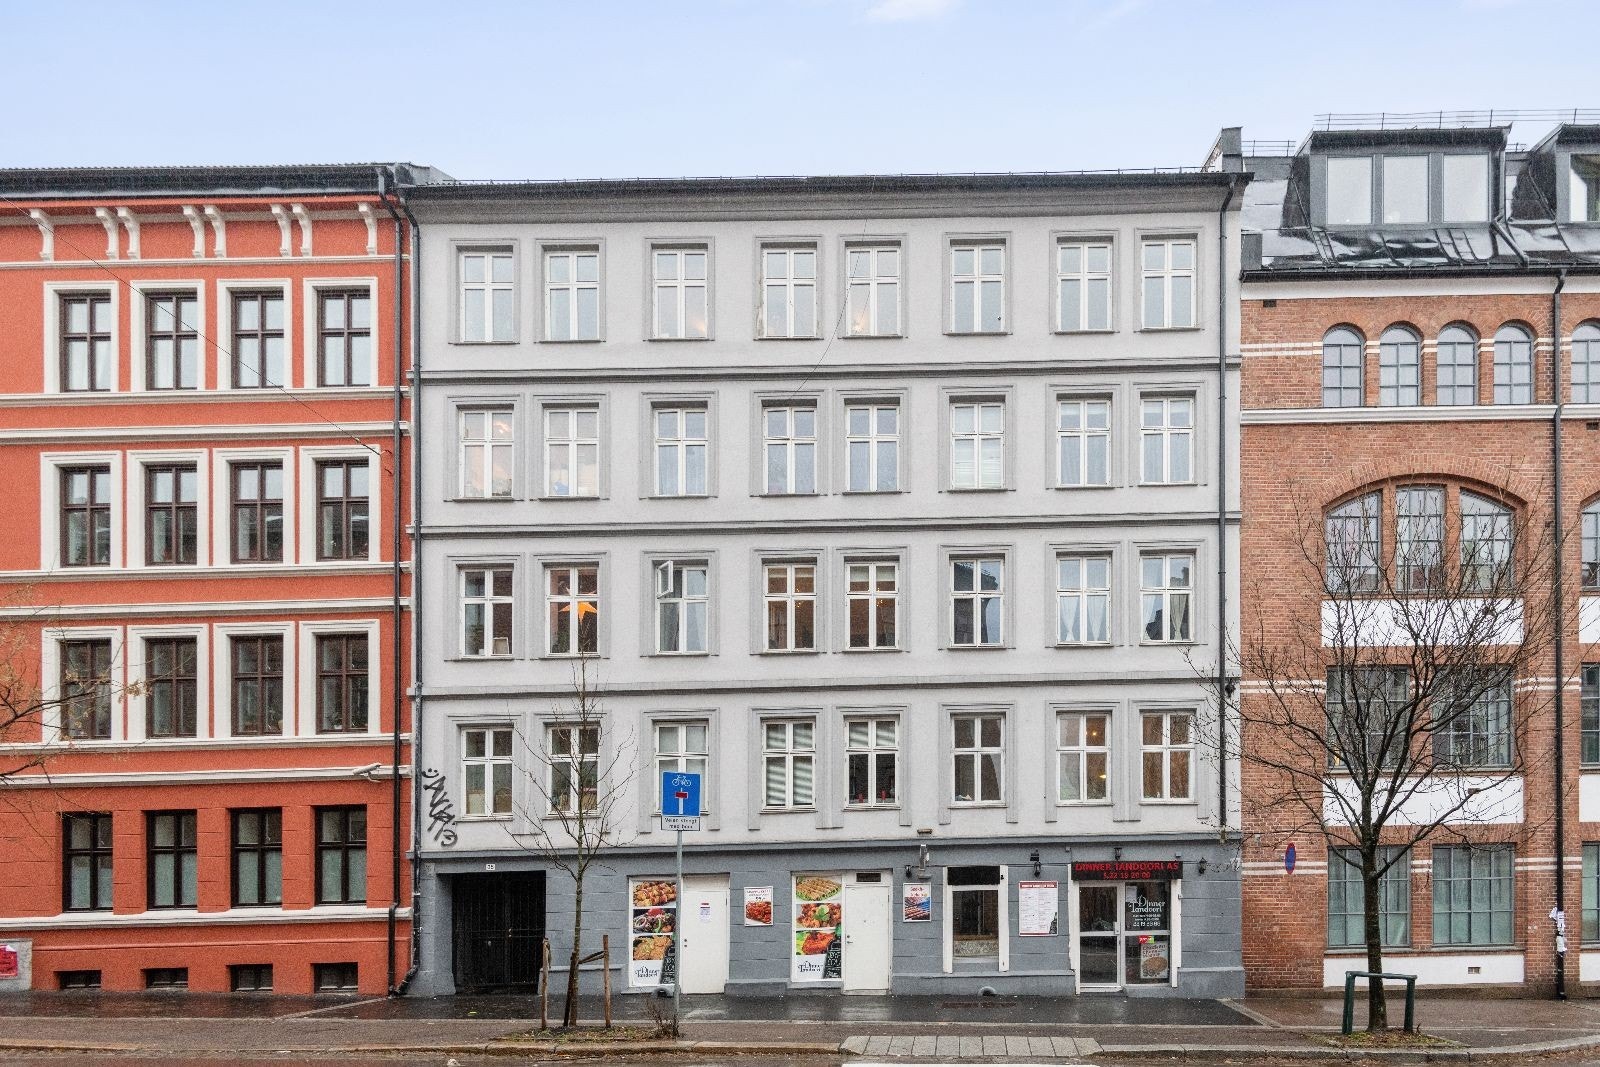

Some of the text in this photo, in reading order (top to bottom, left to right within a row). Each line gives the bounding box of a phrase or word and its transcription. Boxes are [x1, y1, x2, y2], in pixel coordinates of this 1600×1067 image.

[1075, 862, 1179, 871] DINNER TANDOORI AS
[1128, 901, 1162, 913] Tandoori
[1138, 895, 1166, 907] Dinner
